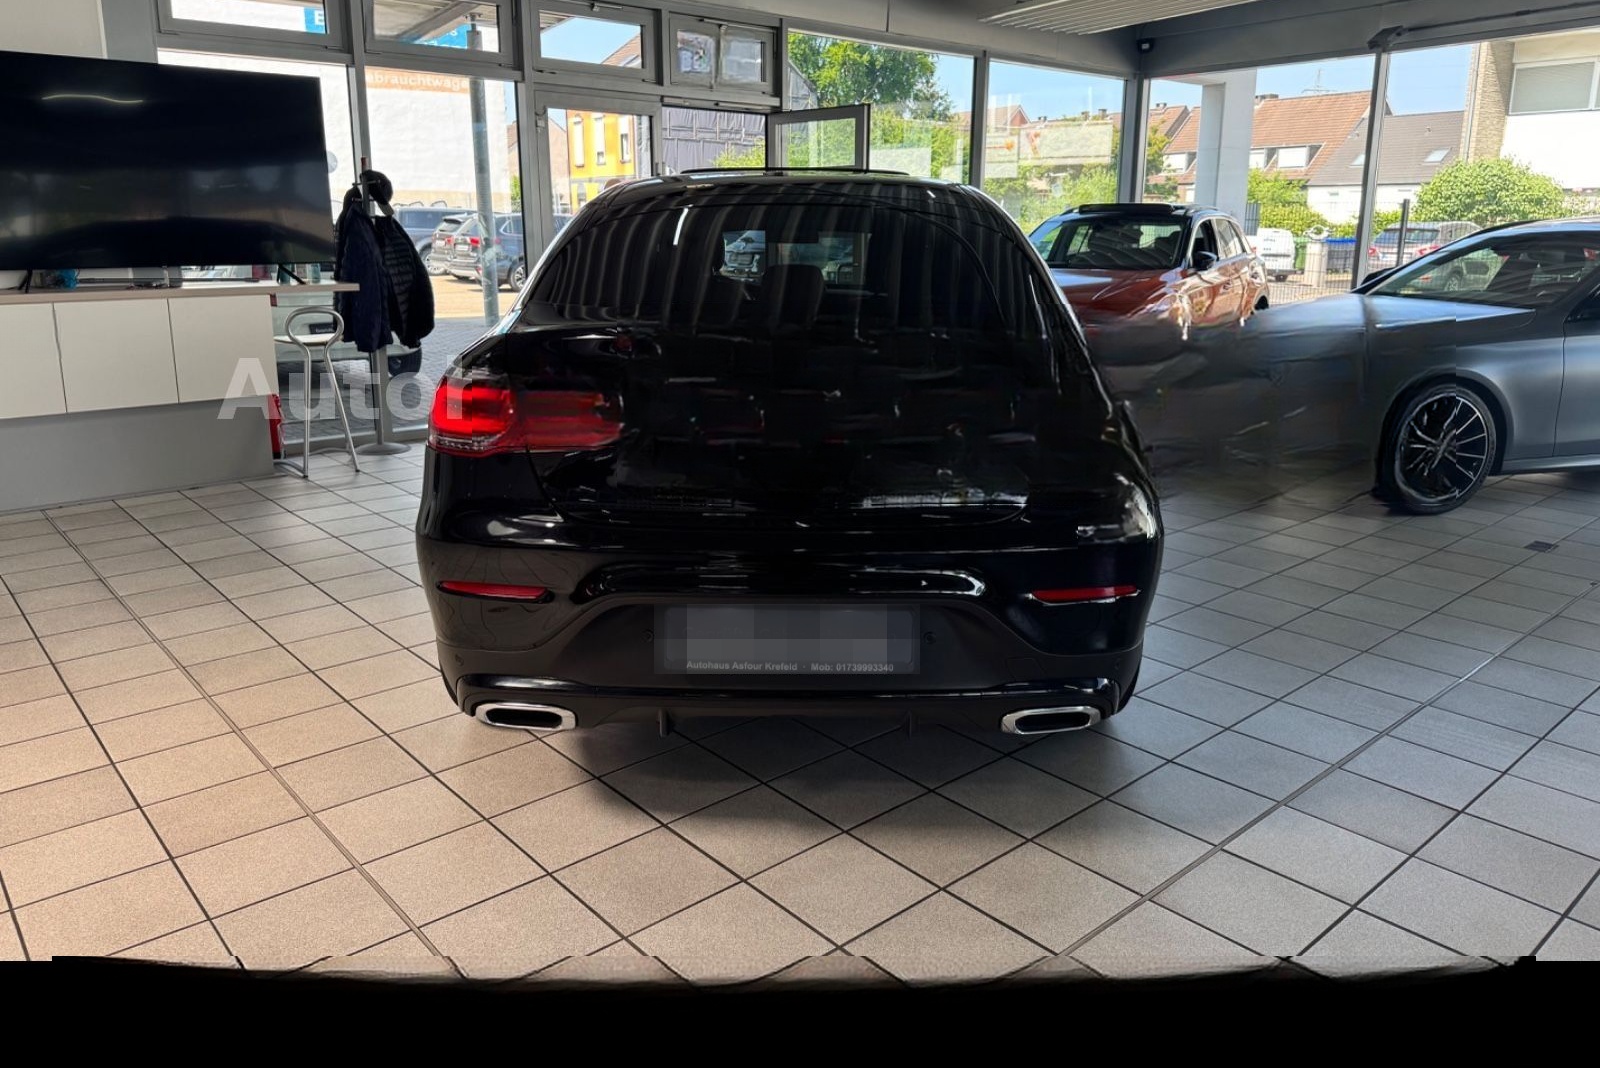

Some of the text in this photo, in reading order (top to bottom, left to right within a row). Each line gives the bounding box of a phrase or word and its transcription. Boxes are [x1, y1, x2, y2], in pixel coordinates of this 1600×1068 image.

[686, 660, 894, 672] Autohaus Asfour Krefeld Mob: 01739993340
